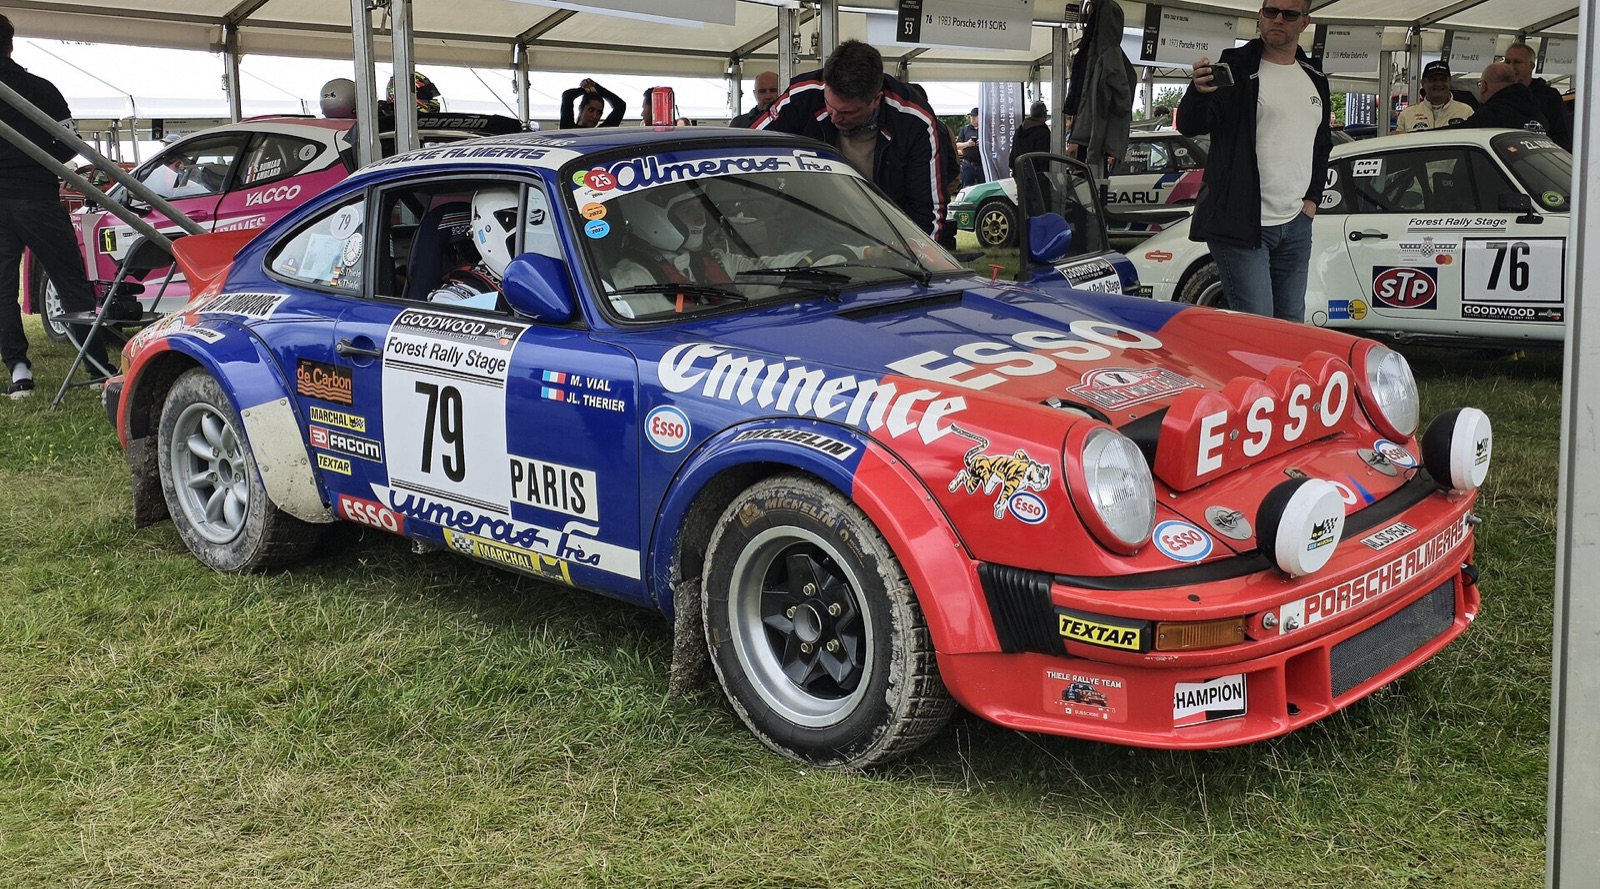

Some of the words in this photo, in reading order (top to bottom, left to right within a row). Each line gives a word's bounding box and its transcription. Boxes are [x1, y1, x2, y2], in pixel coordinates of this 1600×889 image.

[904, 21, 913, 35] 53
[925, 14, 933, 24] 76
[938, 15, 952, 26] 1983
[952, 17, 976, 29] Porsche
[977, 19, 988, 29] 911
[1178, 39, 1195, 50] Porsche
[304, 148, 310, 157] 6
[441, 147, 547, 161] ALMERAS
[590, 173, 612, 188] 25
[608, 155, 792, 192] Almeras
[245, 184, 302, 207] YACCO
[1108, 191, 1160, 204] BARU
[338, 213, 352, 231] 79
[1408, 217, 1443, 226] Forest
[1445, 217, 1473, 227] Rally
[1474, 217, 1508, 227] Stage
[103, 229, 112, 252] 6
[1063, 262, 1101, 279] GOODWOOD
[1485, 241, 1531, 292] 76
[1105, 280, 1121, 294] Stage
[1379, 272, 1429, 301] STP
[1463, 305, 1536, 317] GOODWOOD
[400, 313, 485, 336] GOODWOOD
[386, 336, 428, 359] Forest
[428, 343, 463, 368] Rally
[465, 349, 506, 375] Stage
[884, 320, 1163, 391] ESSO
[297, 364, 311, 383] de
[312, 367, 352, 391] Carbon
[570, 374, 583, 387] M.
[586, 376, 612, 392] VIAL
[566, 392, 581, 405] JL.
[582, 394, 626, 413] THERIER
[657, 342, 967, 446] Eminence
[311, 407, 349, 427] MARCHAL
[1196, 370, 1349, 477] ESSO
[414, 380, 466, 483] 79
[735, 429, 852, 456] MICHELIN
[329, 433, 381, 459] FACOM
[318, 454, 350, 473] TEXTAR
[509, 457, 587, 515] PARIS
[340, 498, 399, 534] ESSO
[764, 497, 837, 529] MICHELIN
[477, 542, 534, 569] MARCHAL
[1303, 558, 1403, 626] PORSCHE
[1404, 515, 1465, 580] ALMERAS
[1059, 617, 1138, 647] TEXTAR
[1046, 670, 1071, 682] THIELE
[1072, 674, 1100, 686] RALLYE
[1101, 678, 1122, 690] TEAM
